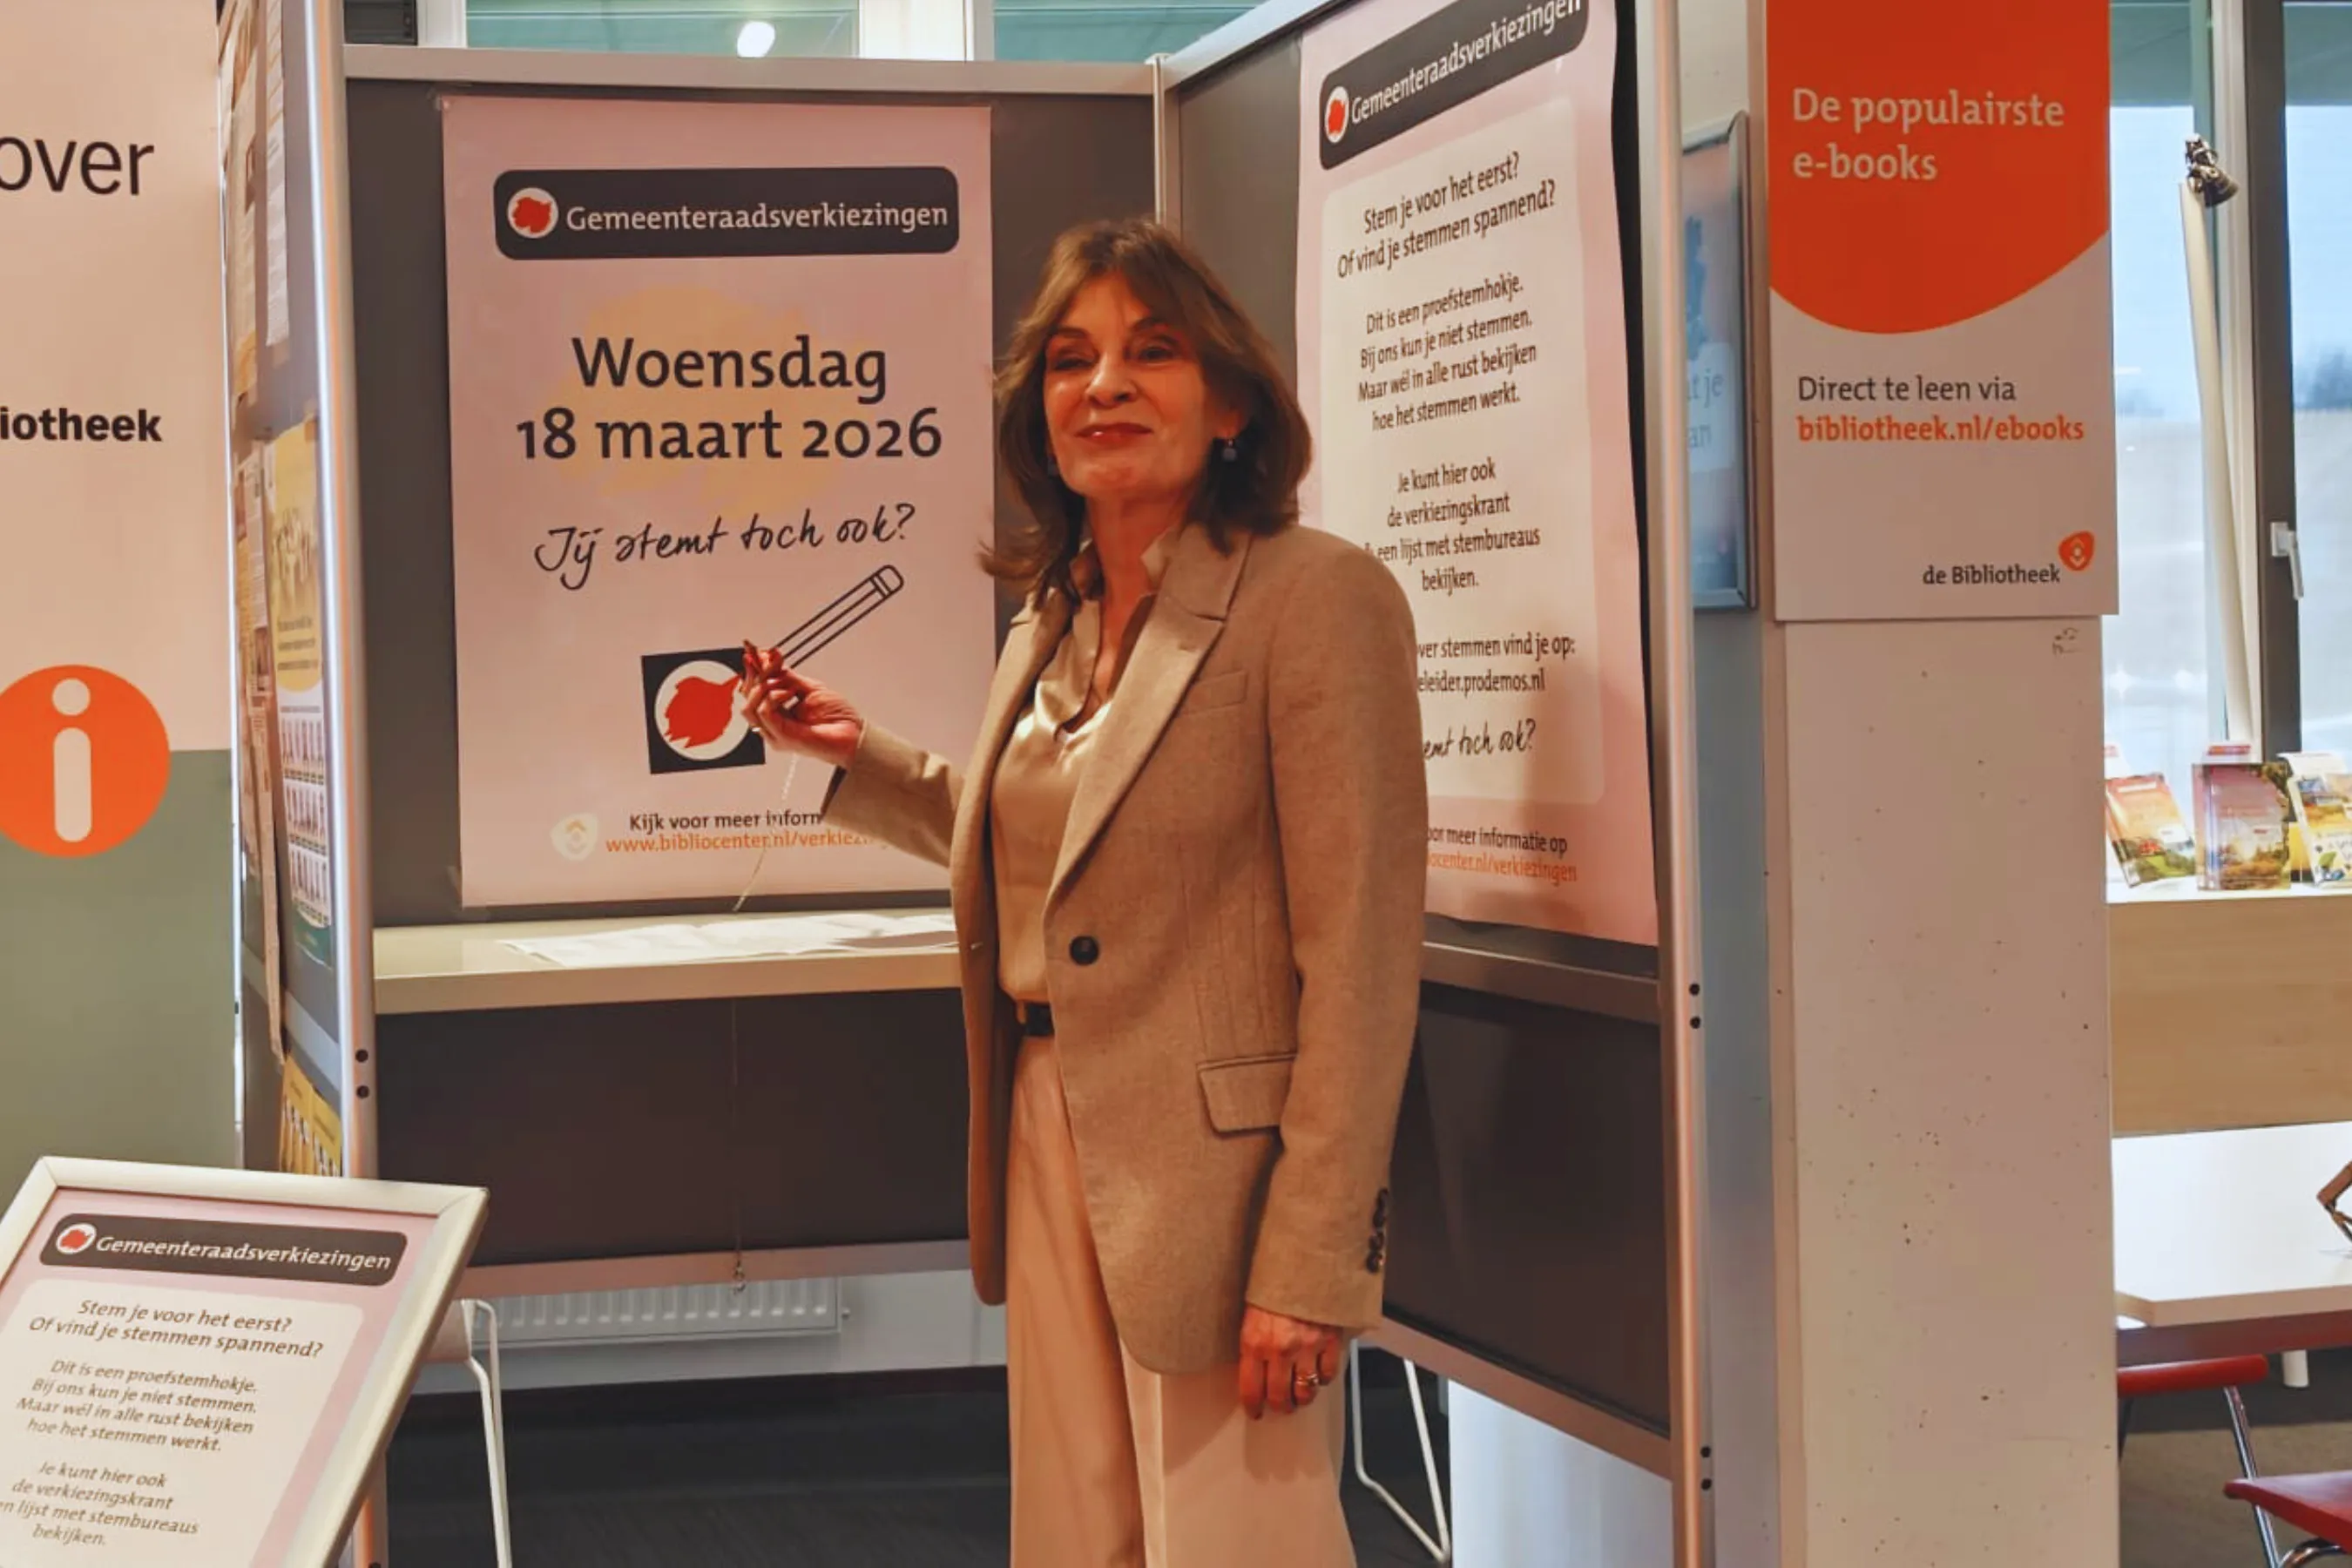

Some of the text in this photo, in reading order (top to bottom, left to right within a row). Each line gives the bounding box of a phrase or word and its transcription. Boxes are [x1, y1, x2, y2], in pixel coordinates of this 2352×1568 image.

[1351, 0, 1580, 124] Gemeenteraadsverkiezingen
[1793, 88, 2065, 134] De populairste
[0, 136, 155, 197] over
[1792, 141, 1938, 180] e-books
[1364, 151, 1519, 234] Stem je voor het eerst?
[566, 203, 948, 233] Gemeenteraadsverkiezingen
[1337, 179, 1556, 278] Of vind je stemmen spannend?
[1367, 272, 1524, 335] Dit is een proefstemhokje.
[1361, 309, 1532, 374] Bij ons kun je niet stemmen.
[571, 335, 886, 404] Woensdag
[1358, 381, 1388, 402] Maar
[1412, 368, 1423, 389] in
[1426, 361, 1449, 386] alle
[1451, 355, 1478, 380] rust
[1481, 342, 1537, 375] bekijken
[1372, 382, 1521, 431] hoe het stemmen werkt.
[1704, 368, 1723, 409] je
[1798, 375, 2016, 402] Direct te leen via
[0, 405, 163, 442] iotheek
[517, 407, 943, 459] 18 maart 2026
[1796, 414, 2085, 443] bibliotheek.nl/ebooks
[1398, 456, 1496, 493] Je kunt hier ook
[1387, 492, 1511, 527] de verkiezingskrant
[615, 516, 727, 562] stemt
[741, 508, 824, 551] toch
[836, 503, 916, 543] ook?
[1400, 537, 1423, 566] lijst
[1426, 533, 1450, 558] met
[1454, 528, 1540, 555] stembureaus
[1422, 566, 1479, 596] bekijken.
[1922, 563, 2061, 585] de Bibliotheek
[1417, 642, 1438, 659] ver
[1442, 637, 1501, 659] stemmen
[1504, 631, 1532, 655] vind
[1535, 632, 1549, 662] je
[1417, 667, 1545, 699] eleider.prodemos.nl
[1423, 717, 1537, 760] emt toch ook?
[630, 808, 822, 835] Kijk voor meer inform
[1446, 828, 1477, 846] meer
[1479, 826, 1547, 852] informatie
[1550, 836, 1567, 859] op
[96, 1236, 391, 1272] Gemeenteraadsverkiezingen
[77, 1299, 293, 1334] Stem je voor het eerst?
[29, 1315, 324, 1359] Of vind je stemmen spannend?
[31, 1377, 258, 1415] Bij ons kun je niet stemmen.
[51, 1359, 259, 1396] Dit is een proefstemhokje.
[16, 1396, 60, 1414] Maar
[94, 1403, 112, 1420] in
[113, 1407, 145, 1423] alle
[147, 1410, 180, 1426] rust
[183, 1411, 254, 1435] bekijken
[27, 1417, 222, 1452] hoe het stemmen werkt.
[57, 1463, 98, 1480] kunt
[99, 1467, 134, 1484] hier
[135, 1473, 169, 1488] ook
[11, 1478, 174, 1511] de verkiezingskrant
[31, 1523, 108, 1546] bekijken.
[51, 1505, 87, 1522] met
[87, 1511, 201, 1536] stembureaus
